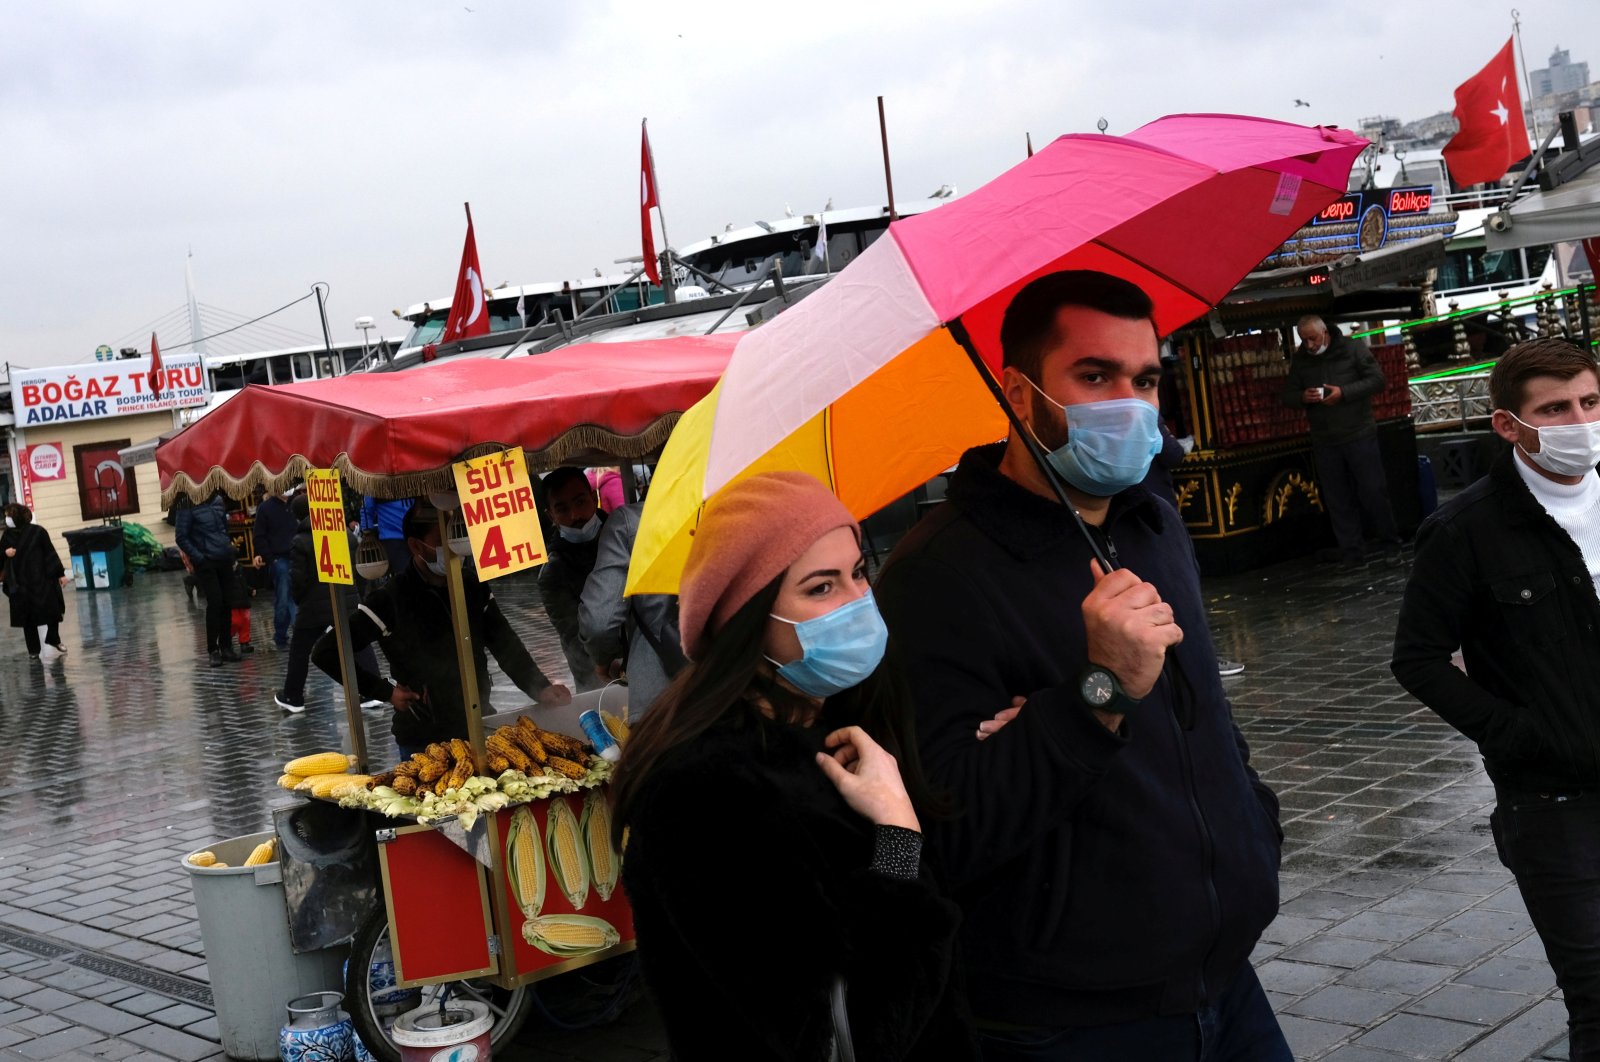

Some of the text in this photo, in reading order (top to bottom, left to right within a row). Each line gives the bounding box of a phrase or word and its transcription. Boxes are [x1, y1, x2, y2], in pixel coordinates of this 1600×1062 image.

[21, 362, 199, 386] HERGÜN EVERYDAY
[22, 367, 202, 407] BOĞAZ TURU
[178, 388, 203, 397] TOUR
[27, 400, 108, 424] ADALAR
[117, 404, 144, 413] PRINCE
[307, 475, 341, 503] KÖZDE
[465, 459, 515, 494] SÜT
[309, 508, 345, 532] MISIR
[463, 486, 534, 527] MISIR
[319, 535, 350, 579] 4 TL
[478, 525, 541, 570] 4 TL
